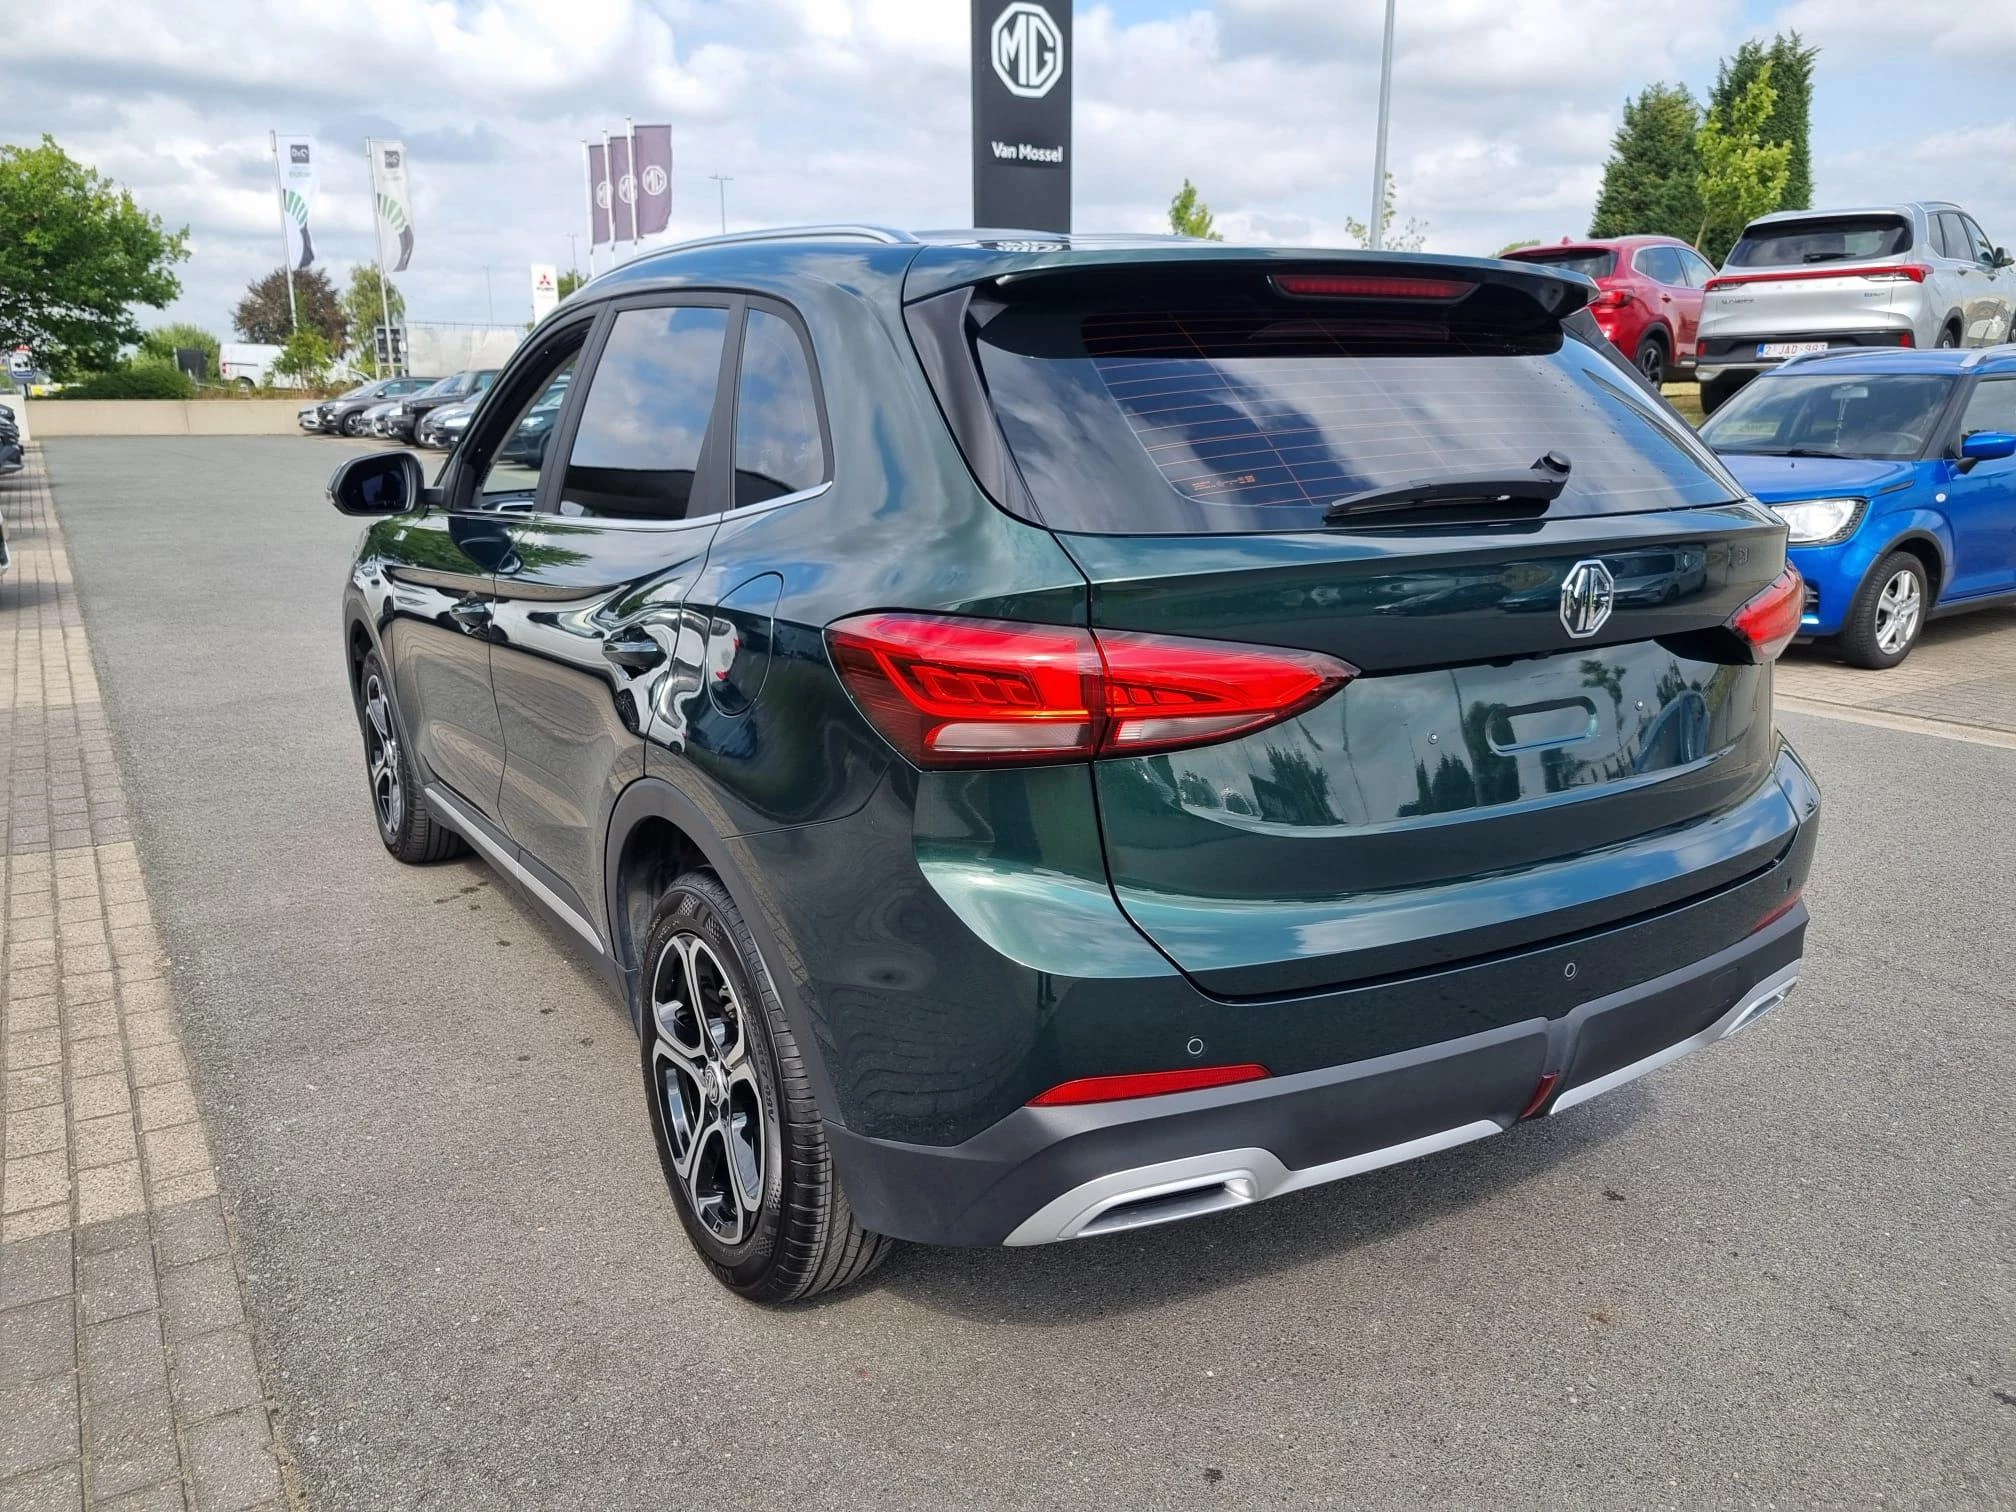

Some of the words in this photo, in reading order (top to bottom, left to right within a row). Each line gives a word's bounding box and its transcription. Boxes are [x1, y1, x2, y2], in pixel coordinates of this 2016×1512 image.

[996, 10, 1058, 91] MG
[991, 141, 1017, 159] Van
[1019, 143, 1064, 163] Mossel
[644, 167, 667, 194] MG
[1563, 564, 1611, 634] MG
